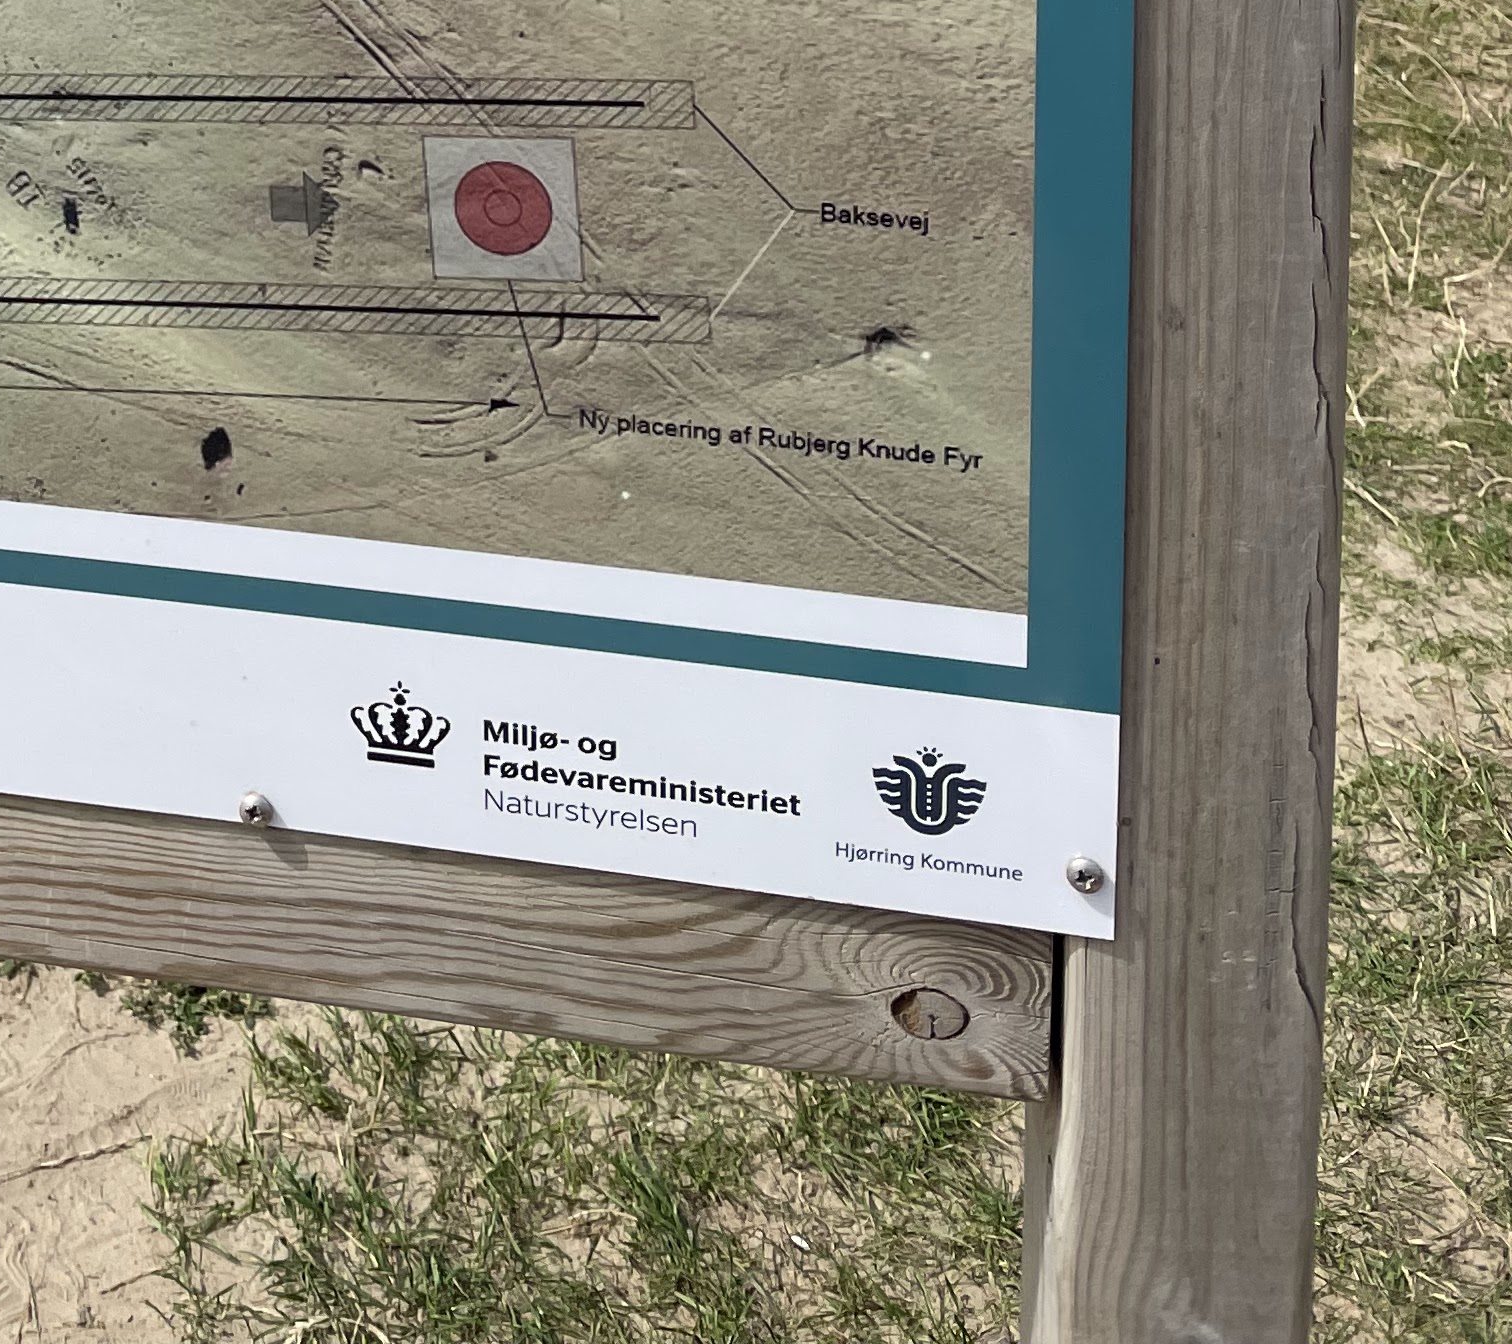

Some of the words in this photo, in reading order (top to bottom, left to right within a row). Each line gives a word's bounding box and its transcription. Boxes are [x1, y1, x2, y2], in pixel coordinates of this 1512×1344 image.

[820, 201, 929, 237] Baksevej
[578, 408, 610, 436] Ny
[616, 413, 722, 447] placering
[728, 424, 754, 446] af
[757, 426, 852, 461] Rubjerg
[858, 437, 936, 465] Knude
[943, 445, 984, 474] Fyr
[483, 718, 571, 753] Miljø-
[577, 735, 618, 762] og
[483, 753, 802, 817] Fødevareministeriet
[483, 787, 698, 839] Naturstyrelsen
[835, 841, 915, 871] Hjørring
[920, 852, 1024, 882] Kommune
